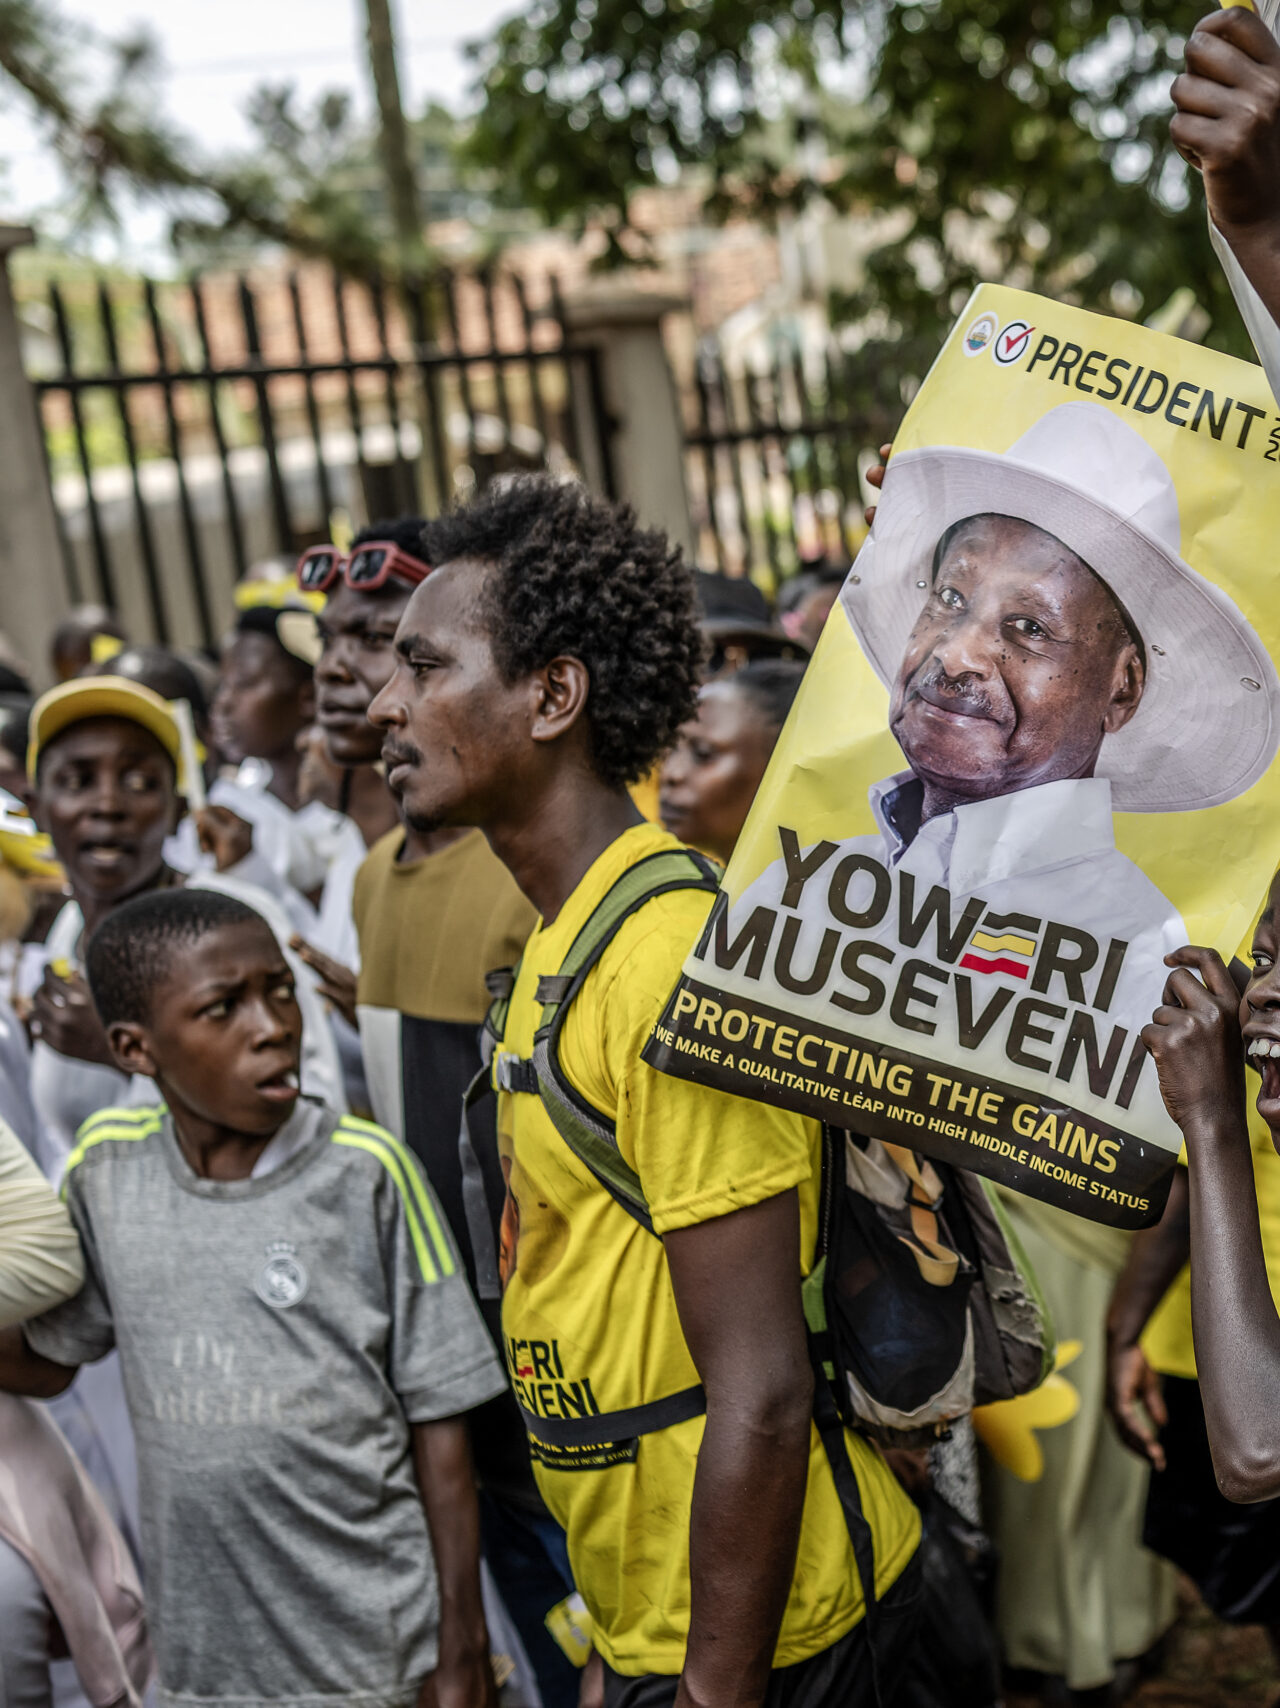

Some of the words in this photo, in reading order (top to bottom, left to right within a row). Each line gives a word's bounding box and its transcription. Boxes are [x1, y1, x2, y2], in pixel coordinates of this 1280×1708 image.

[1026, 334, 1267, 450] PRESIDENT
[694, 891, 1151, 1110] MUSEVENI
[777, 825, 1129, 1013] YOWERI
[656, 1024, 675, 1047] WE
[675, 1035, 722, 1064] MAKE
[723, 1050, 735, 1069] A
[738, 1058, 841, 1102] QUALITATIVE
[843, 1091, 885, 1112] LEAP
[886, 1103, 925, 1127] INTO
[927, 1112, 967, 1141] HIGH
[969, 1131, 1028, 1165] MIDDLE
[1029, 1156, 1088, 1191] INCOME
[1089, 1181, 1150, 1211] STATUS
[671, 988, 914, 1097] PROTECTING
[926, 1073, 1004, 1125] THE
[1012, 1103, 1121, 1174] GAINS
